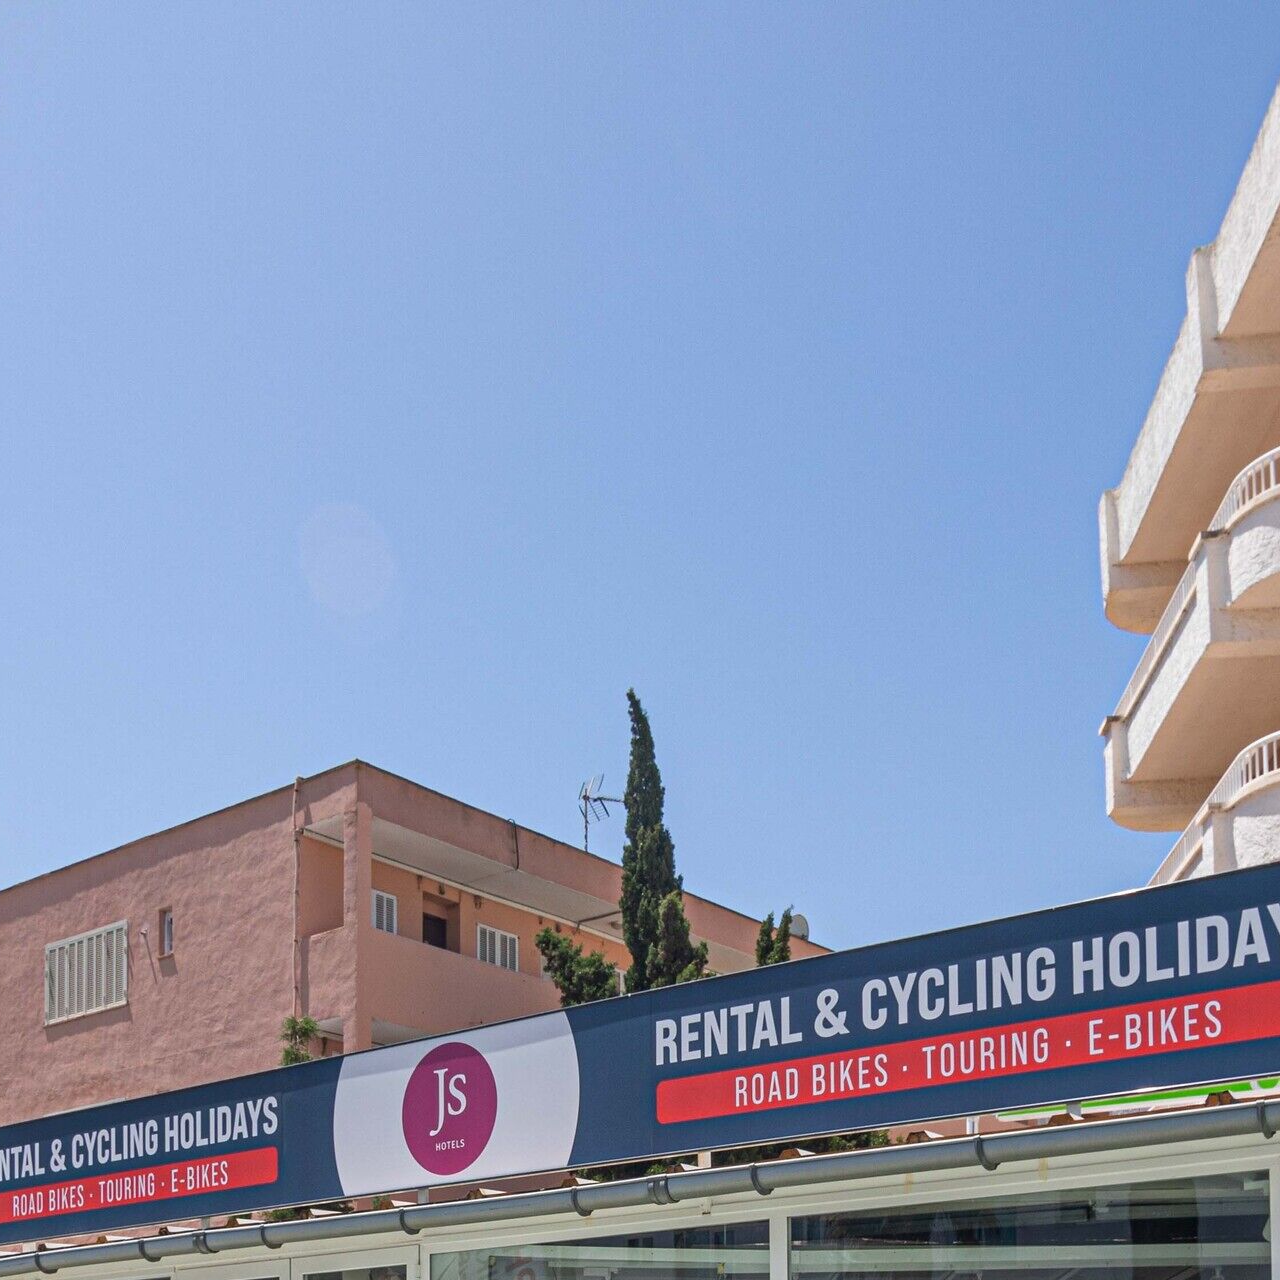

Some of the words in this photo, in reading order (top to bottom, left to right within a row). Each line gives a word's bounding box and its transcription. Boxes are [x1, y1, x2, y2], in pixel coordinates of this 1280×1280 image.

[654, 995, 803, 1066] RENTAL
[812, 987, 847, 1037] &
[861, 946, 1058, 1032] CYCLING
[733, 1065, 800, 1108] ROAD
[810, 1052, 890, 1099] BIKES
[921, 1030, 1051, 1081] TOURING
[1087, 1000, 1225, 1057] E-BIKES
[50, 1138, 67, 1173] &
[71, 1119, 159, 1169] CYCLING
[165, 1096, 279, 1153] HOLIDAYS
[435, 1138, 466, 1151] HOTELS
[12, 1191, 44, 1218] ROAD
[48, 1184, 85, 1212] BIKES
[98, 1172, 156, 1204] TOURING
[171, 1160, 229, 1193] E-BIKES
